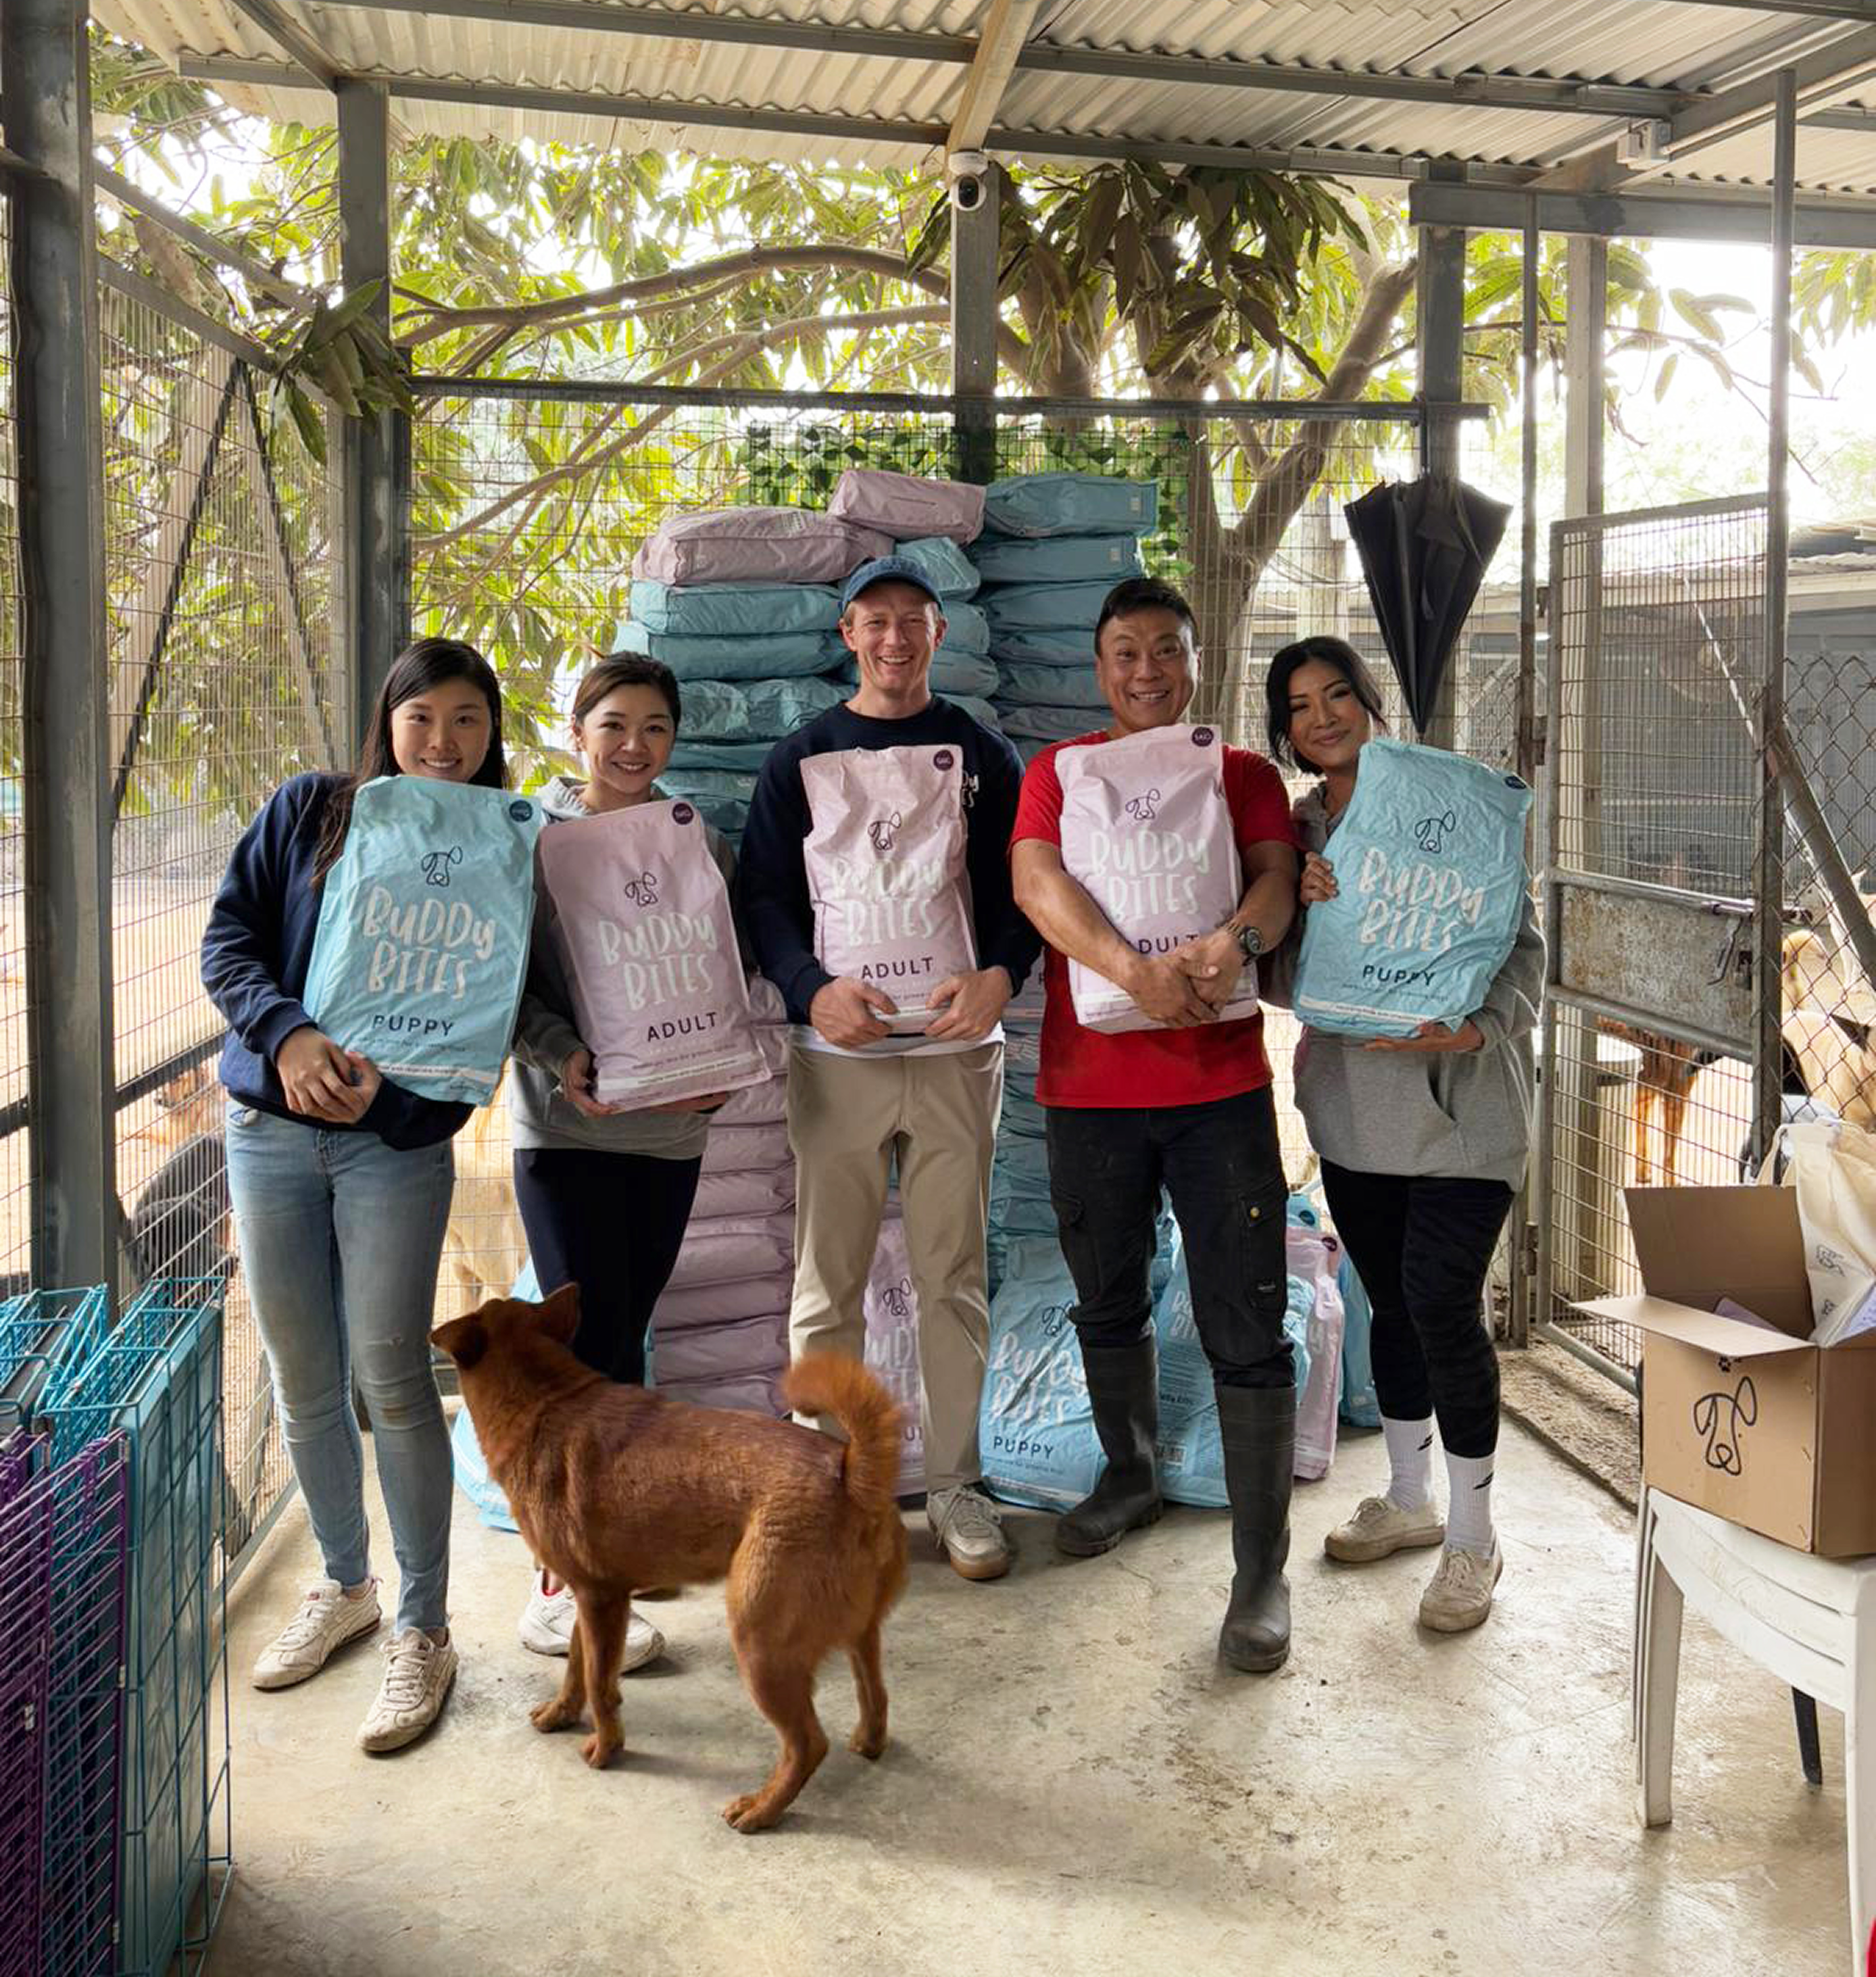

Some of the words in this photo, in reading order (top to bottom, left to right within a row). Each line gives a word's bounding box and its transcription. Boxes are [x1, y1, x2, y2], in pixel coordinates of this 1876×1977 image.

[1106, 872, 1200, 921] BITES
[847, 897, 934, 946] BITES
[367, 940, 473, 1000] BITES
[623, 953, 714, 1012] BITES
[861, 956, 933, 979] ADULT
[1363, 965, 1435, 986] PUPPY
[372, 1014, 455, 1037] PUPPY
[647, 1012, 718, 1042] ADULT
[993, 1436, 1054, 1459] PUPPY
